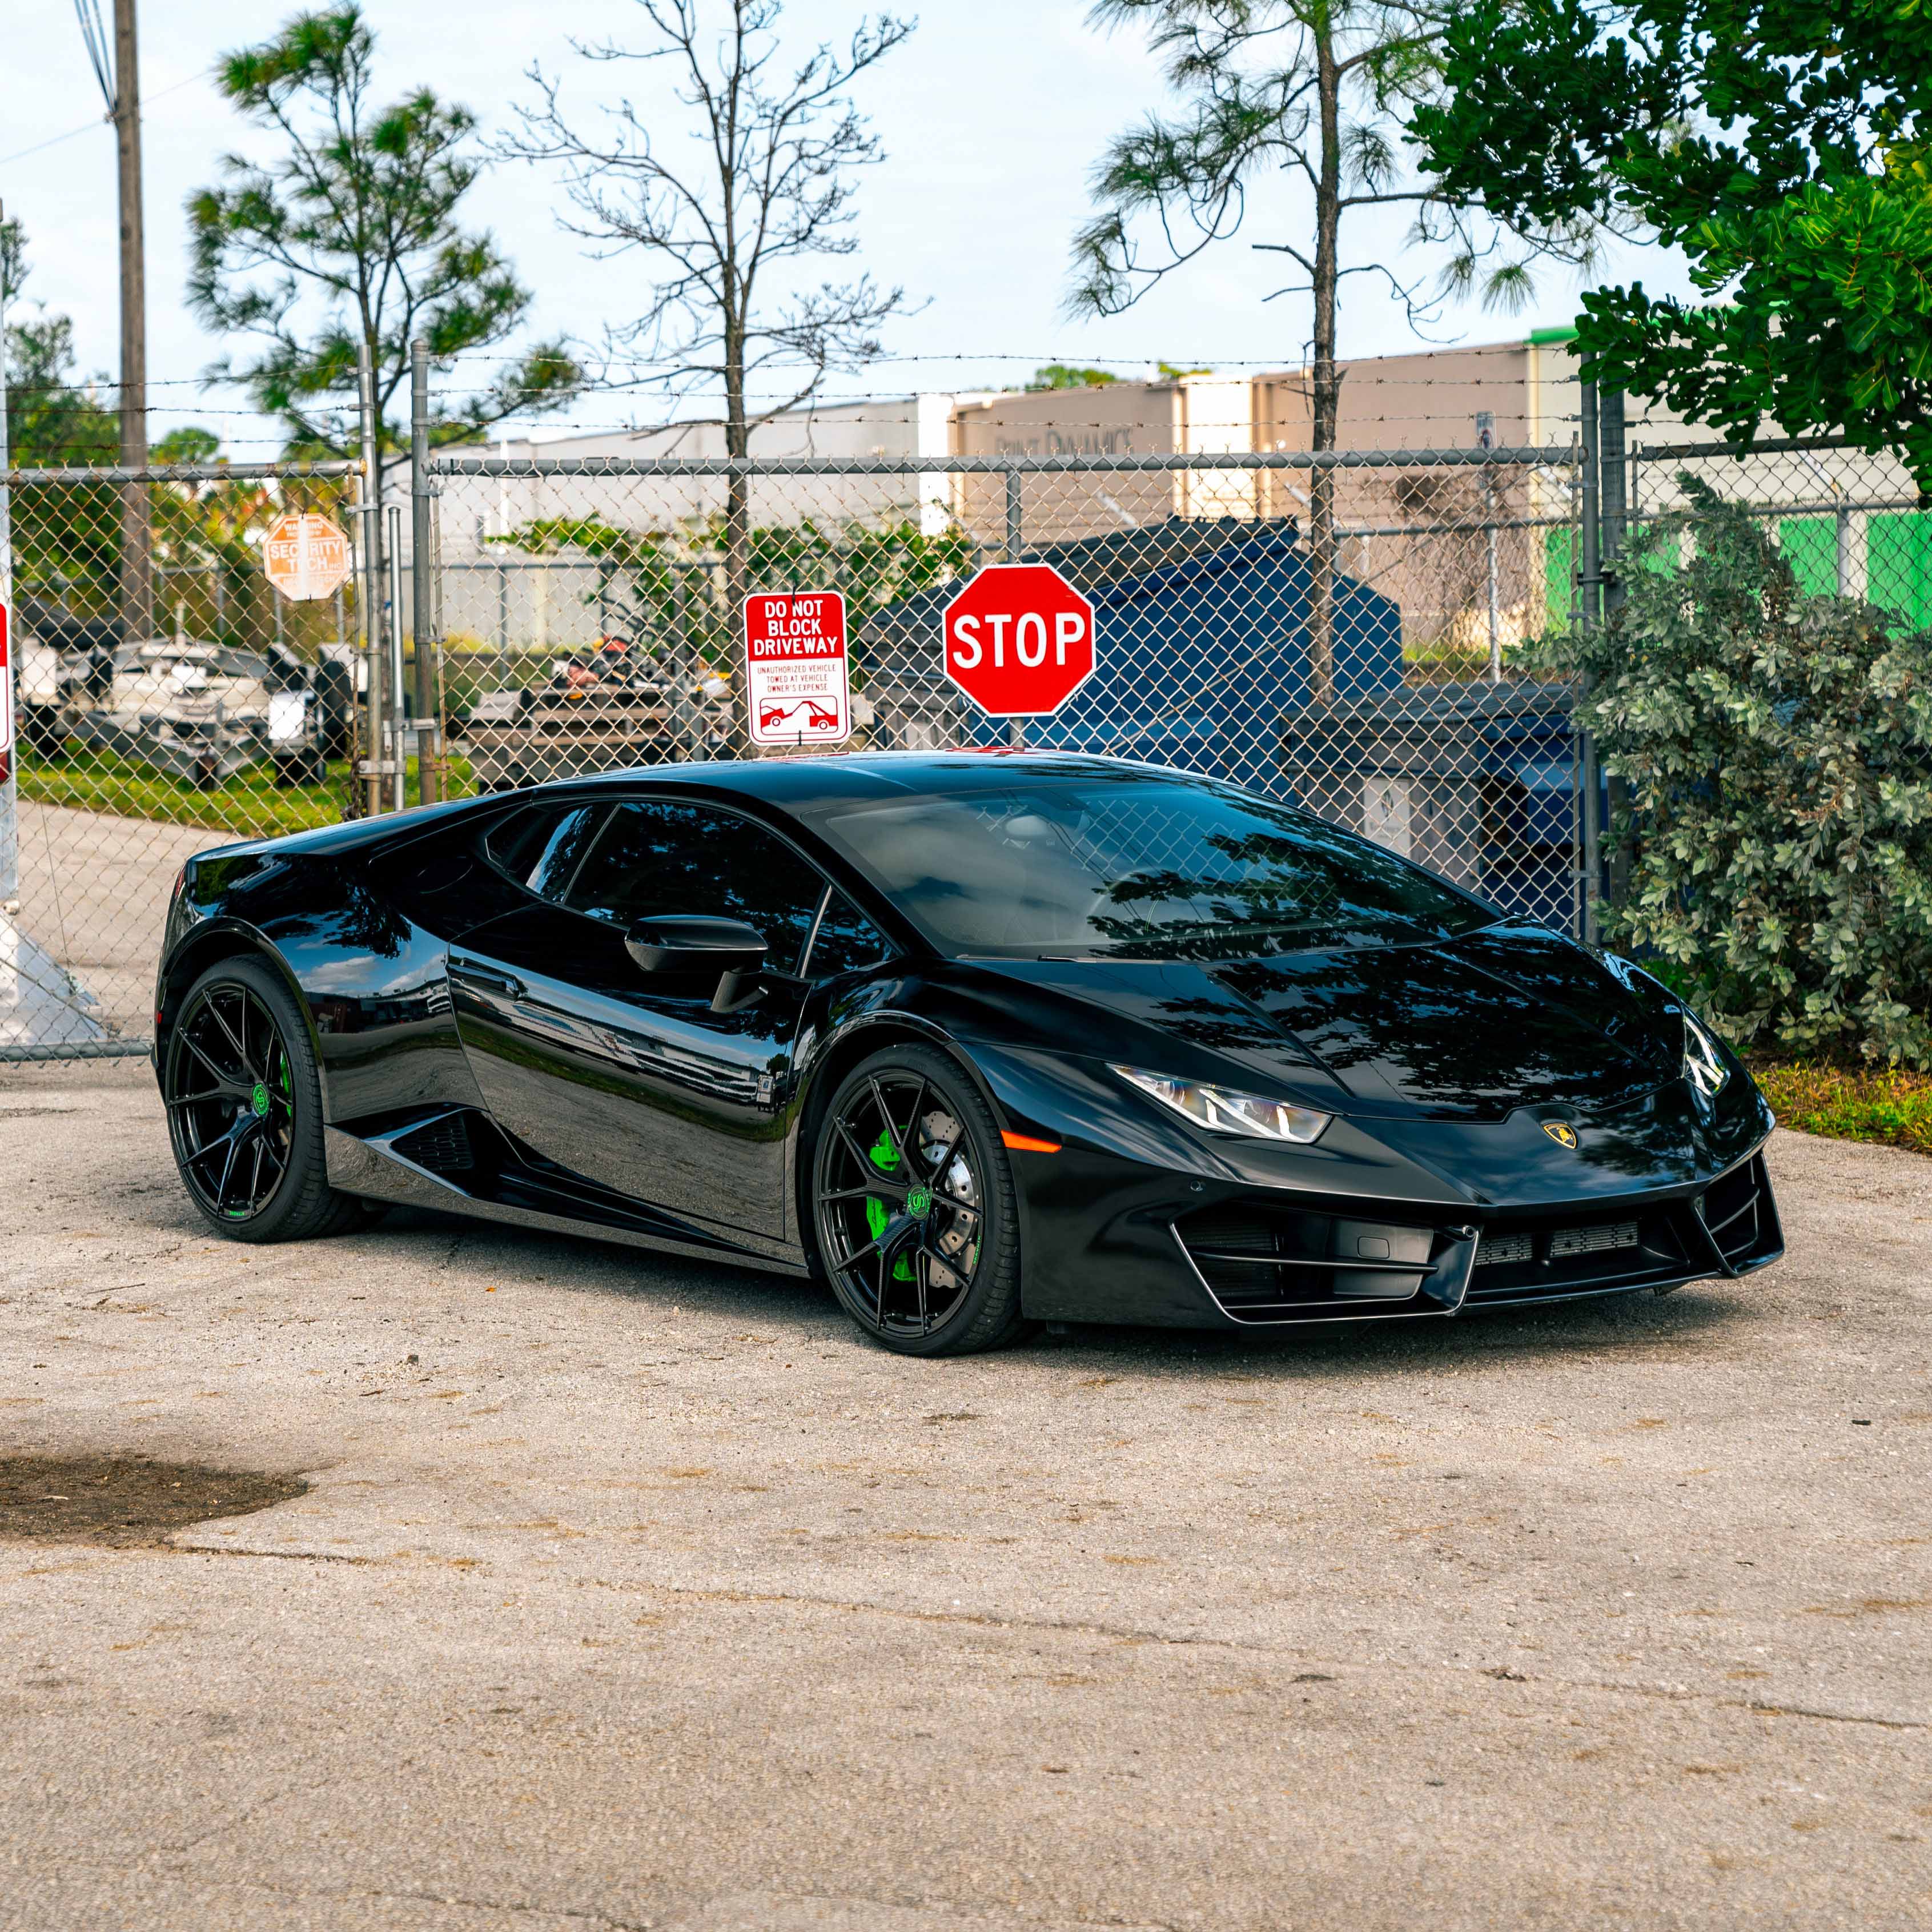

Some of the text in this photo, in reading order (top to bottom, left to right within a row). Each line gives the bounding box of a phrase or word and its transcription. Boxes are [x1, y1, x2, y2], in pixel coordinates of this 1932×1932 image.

[270, 542, 340, 559] SECRITY
[288, 558, 328, 572] TCH
[765, 600, 823, 618] DO NOT
[768, 618, 822, 636] BLOCK
[754, 636, 838, 656] DRIVEWAY
[953, 612, 1085, 669] STOP
[757, 665, 806, 674] UNAUTHORIZED
[767, 684, 796, 693] OWNER'S
